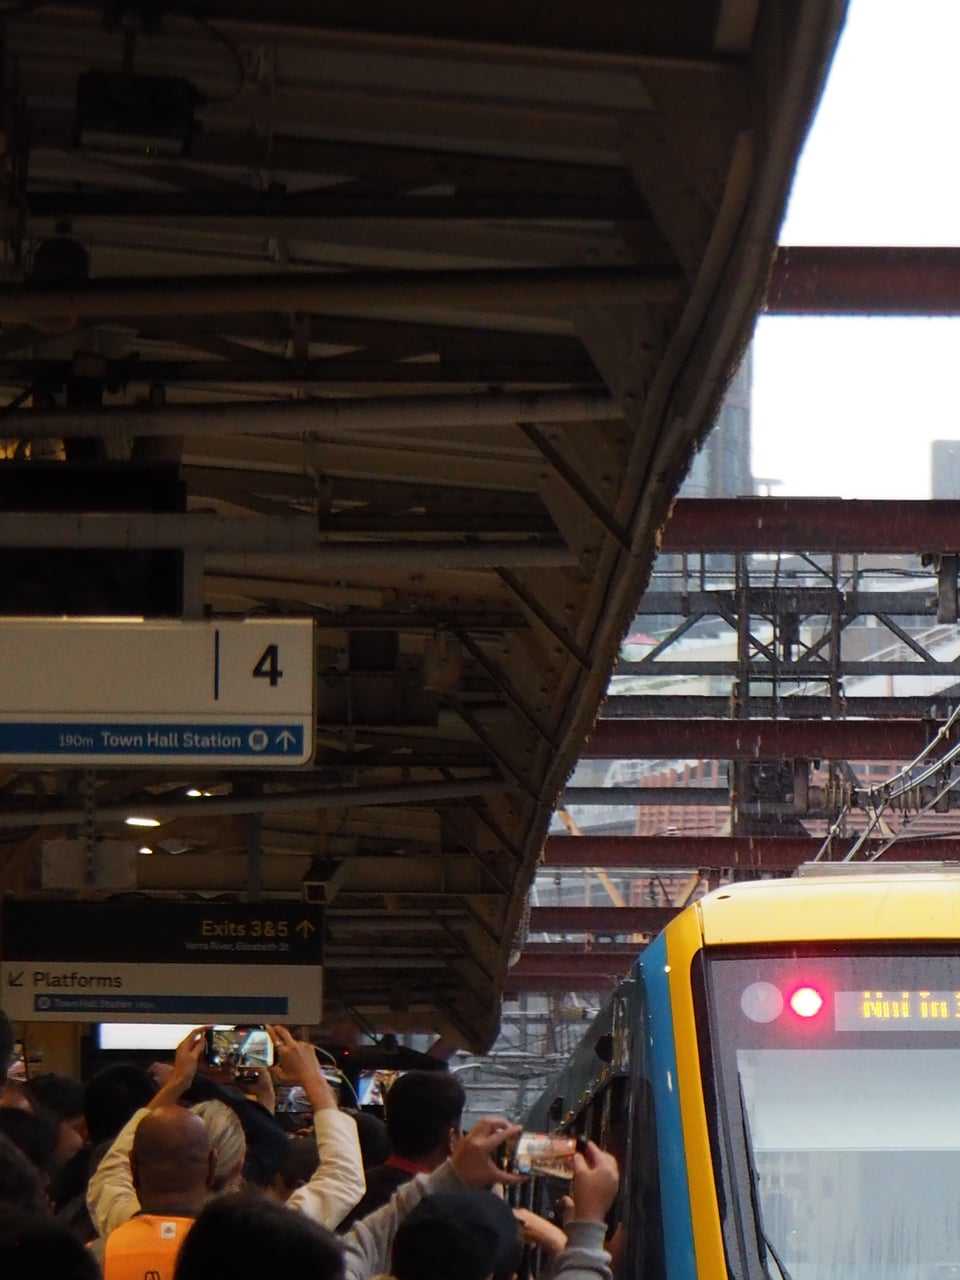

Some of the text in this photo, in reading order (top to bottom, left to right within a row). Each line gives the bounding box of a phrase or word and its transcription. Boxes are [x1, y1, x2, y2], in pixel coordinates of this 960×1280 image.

[252, 644, 283, 687] 4
[59, 733, 241, 748] 190m Town Hall Station
[201, 919, 289, 937] Exits 3&5
[32, 971, 122, 988] Platforms
